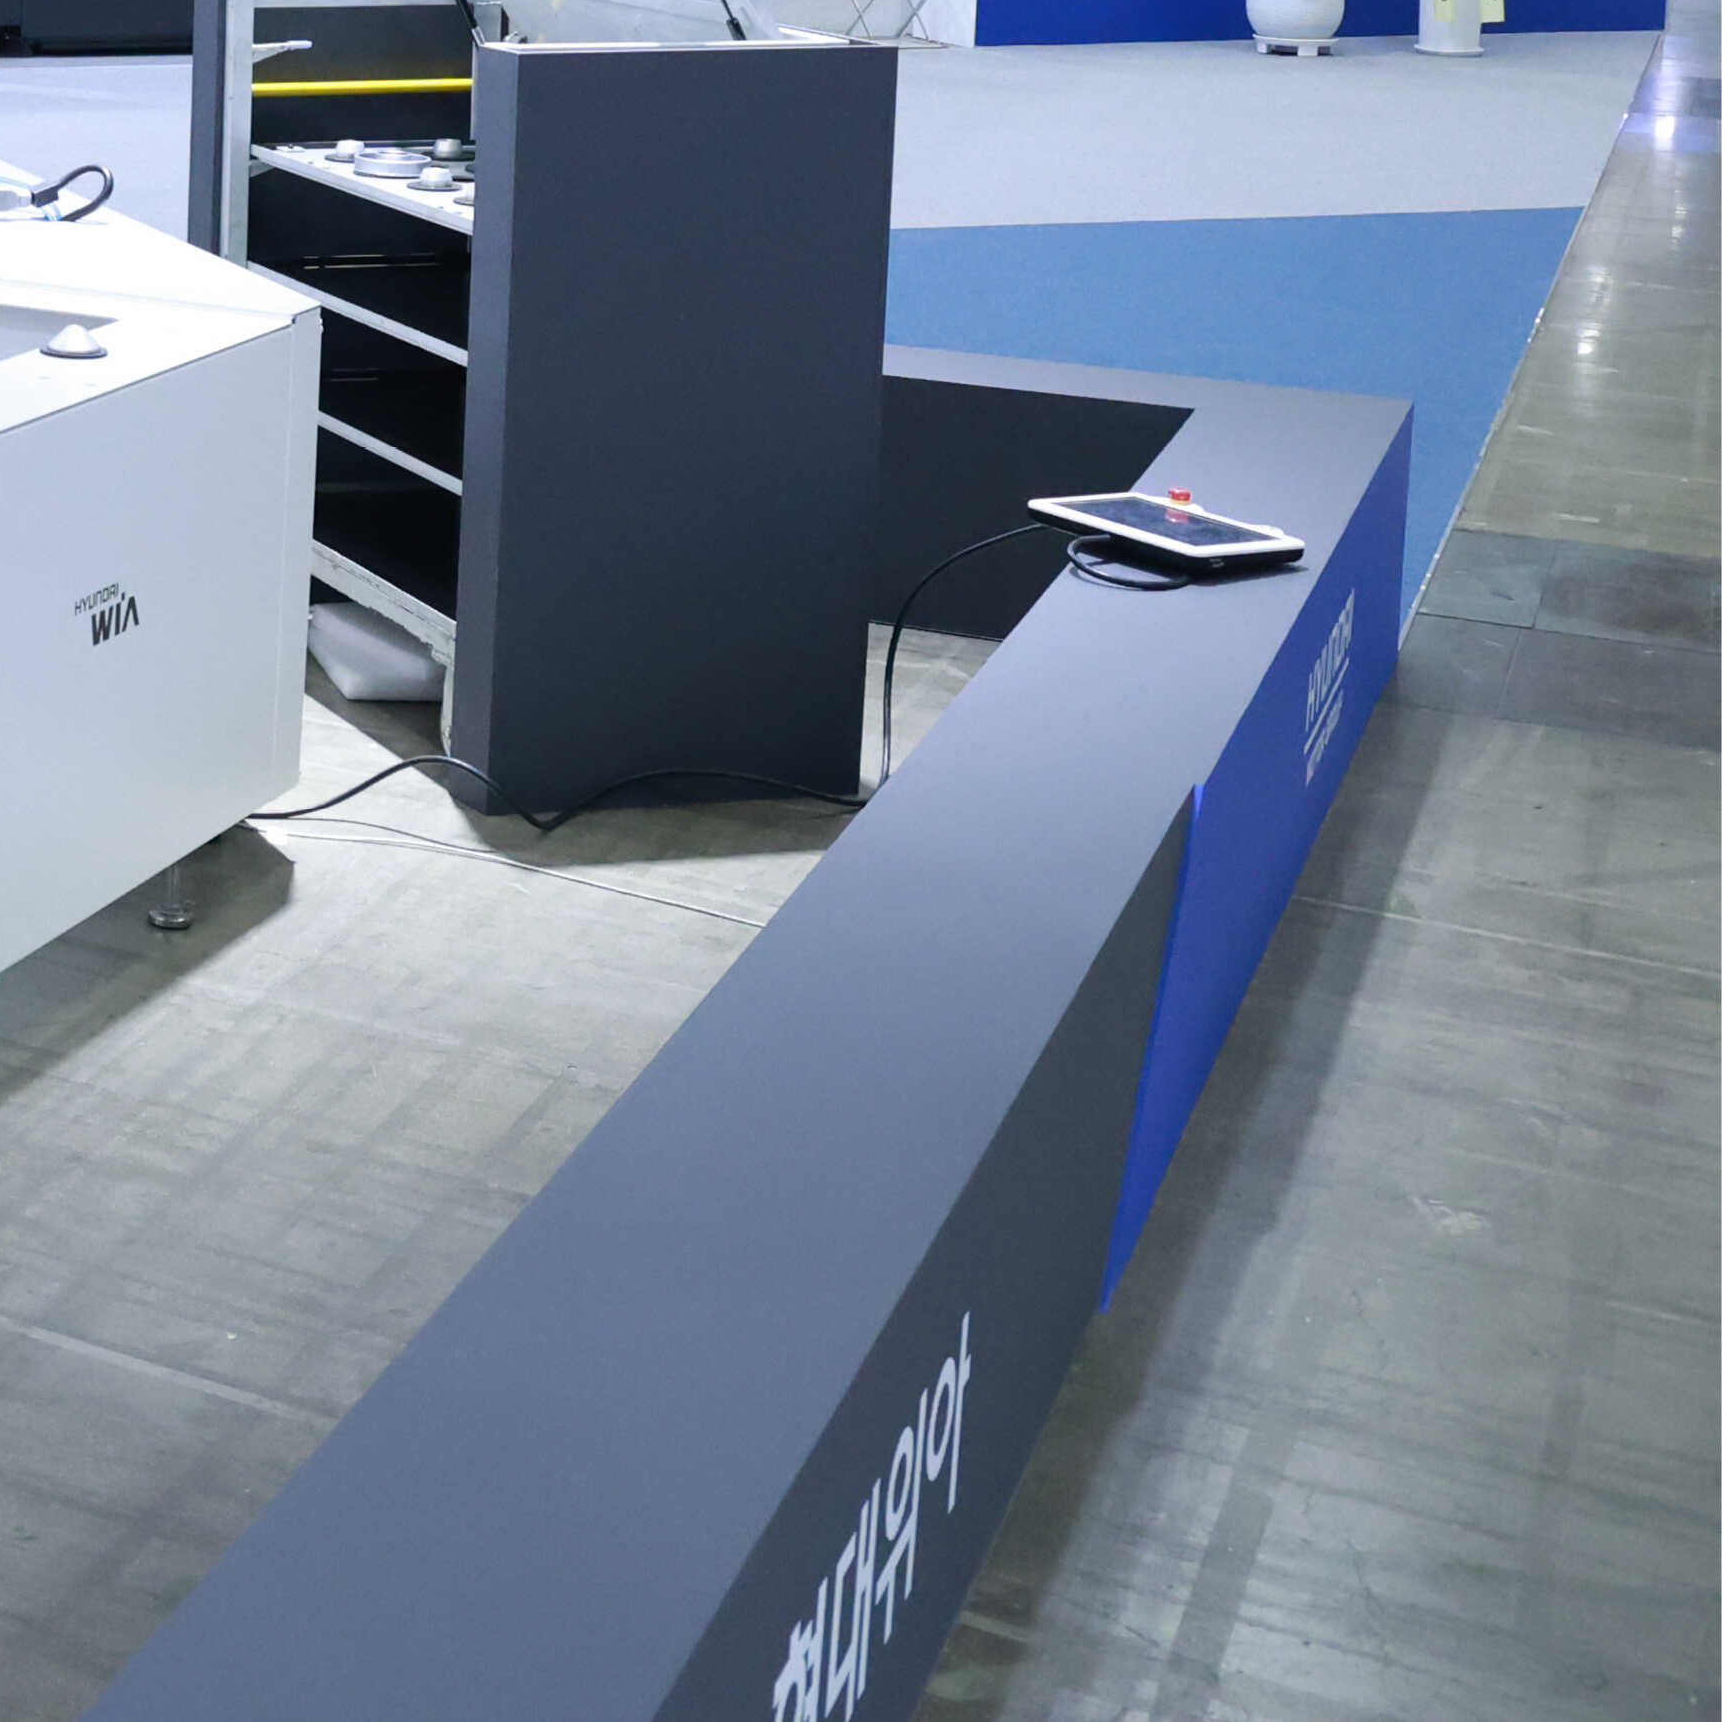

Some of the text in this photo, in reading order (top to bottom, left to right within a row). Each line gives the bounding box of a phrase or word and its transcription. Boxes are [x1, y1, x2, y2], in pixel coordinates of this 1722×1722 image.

[74, 581, 119, 617] HYUNDAI
[91, 591, 140, 647] WIA
[773, 1310, 972, 1722] 현대위아
